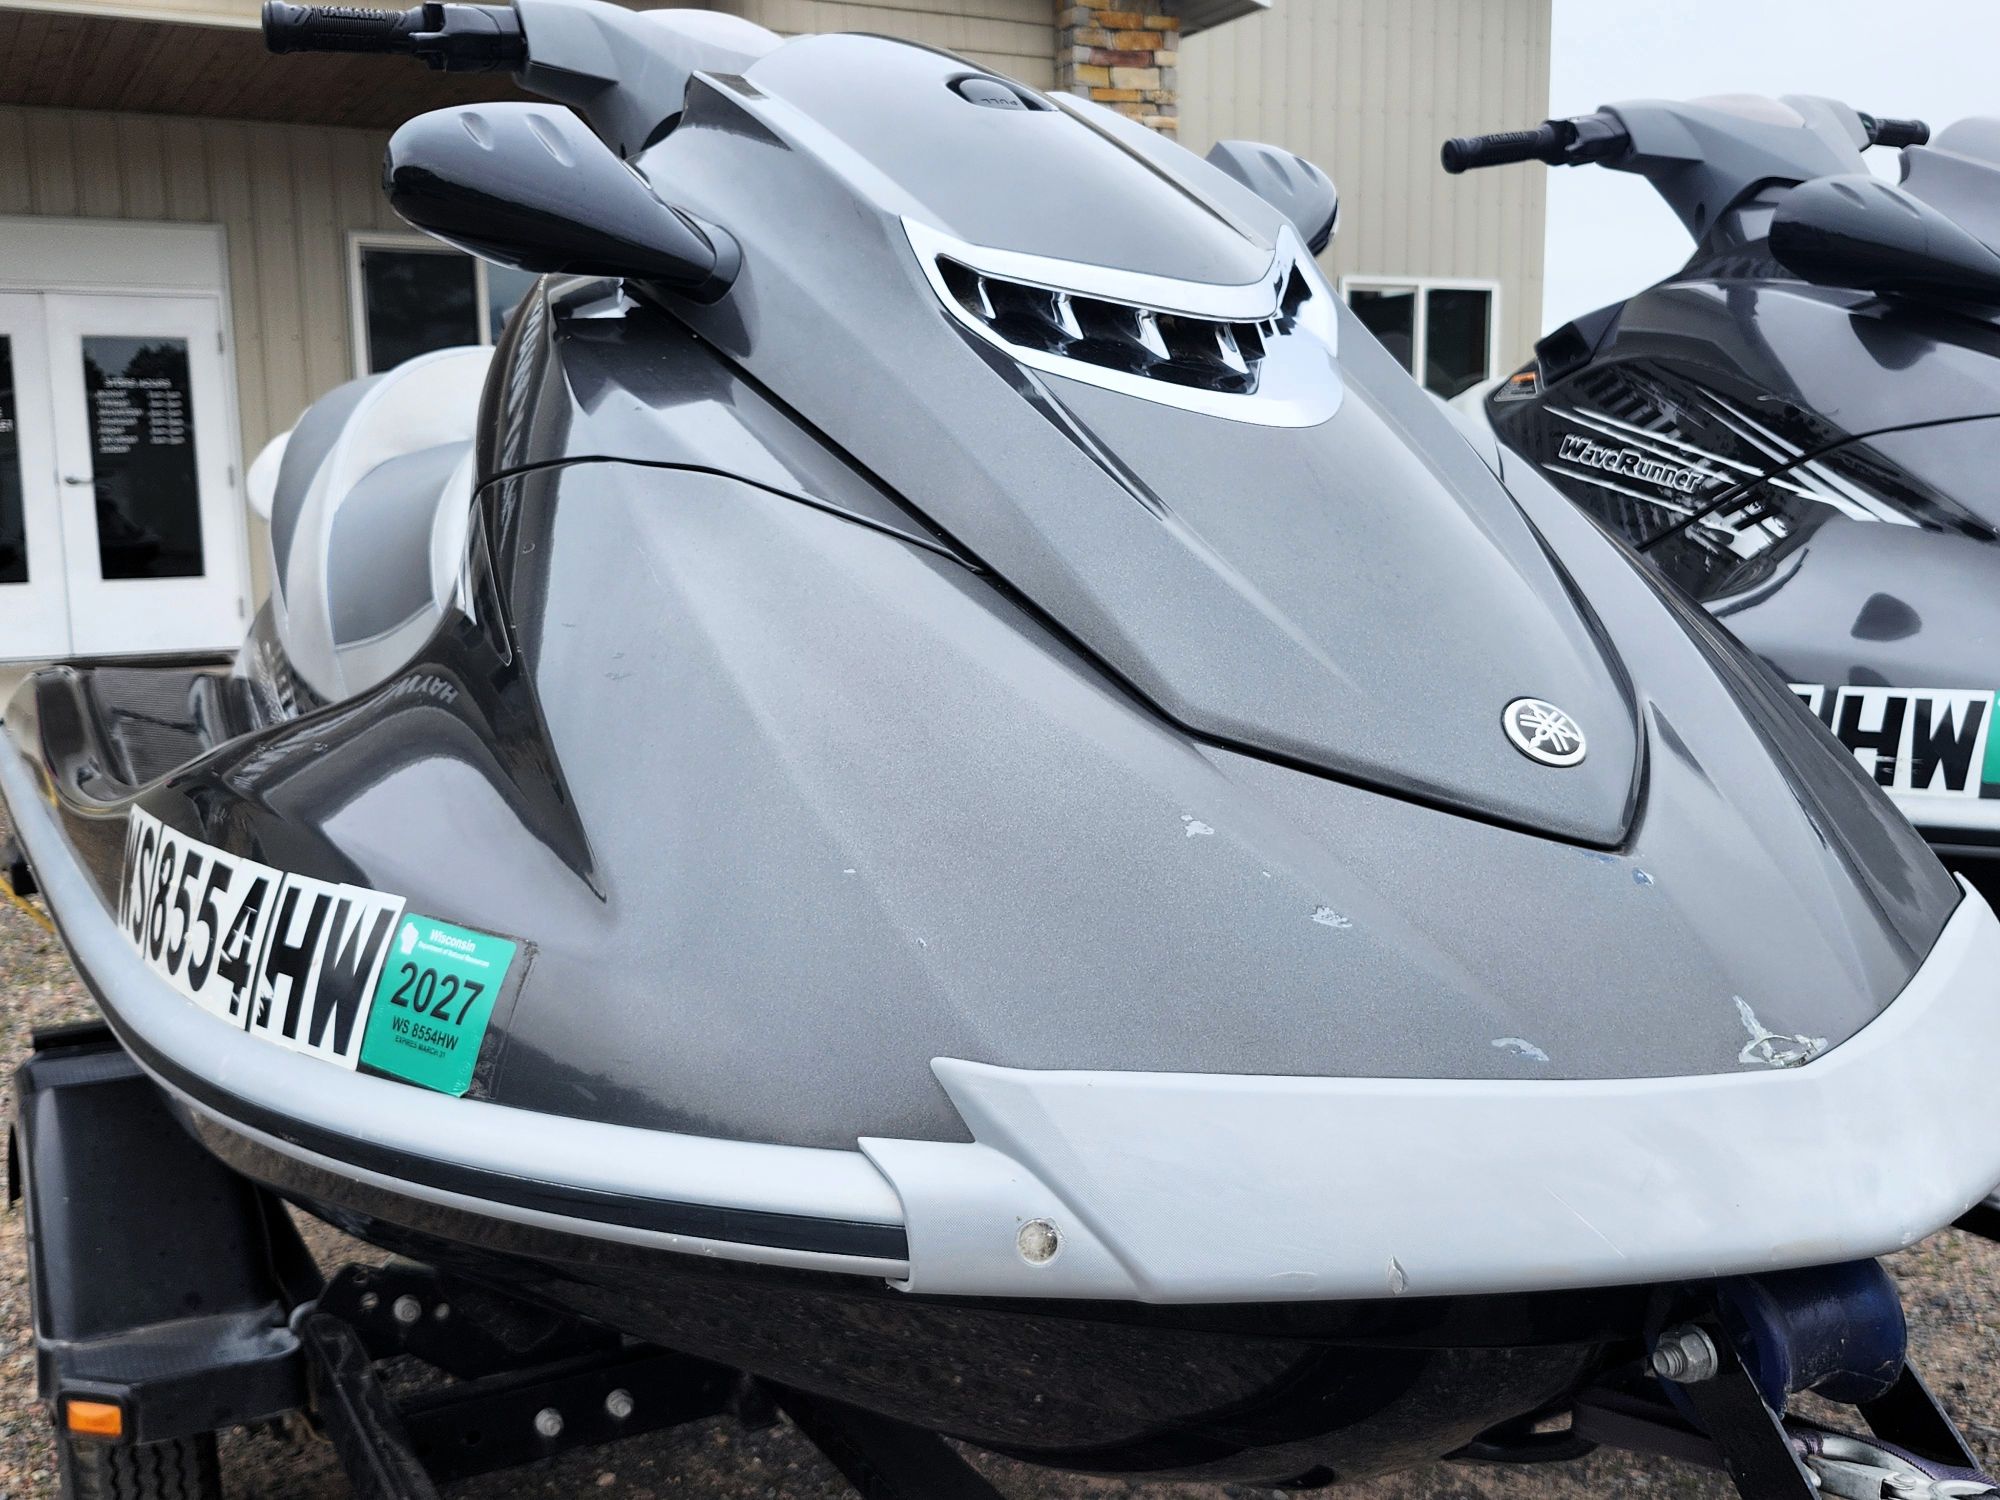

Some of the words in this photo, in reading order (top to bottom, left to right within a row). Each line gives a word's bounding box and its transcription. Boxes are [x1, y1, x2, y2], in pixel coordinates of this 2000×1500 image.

[1558, 433, 1704, 494] WaveRunner
[150, 839, 270, 1016] 8554
[255, 886, 397, 1056] HW
[430, 929, 476, 952] Wisconsin
[391, 961, 485, 1026] 2027
[392, 1015, 410, 1034] WS
[412, 1022, 459, 1050] 8554HW
